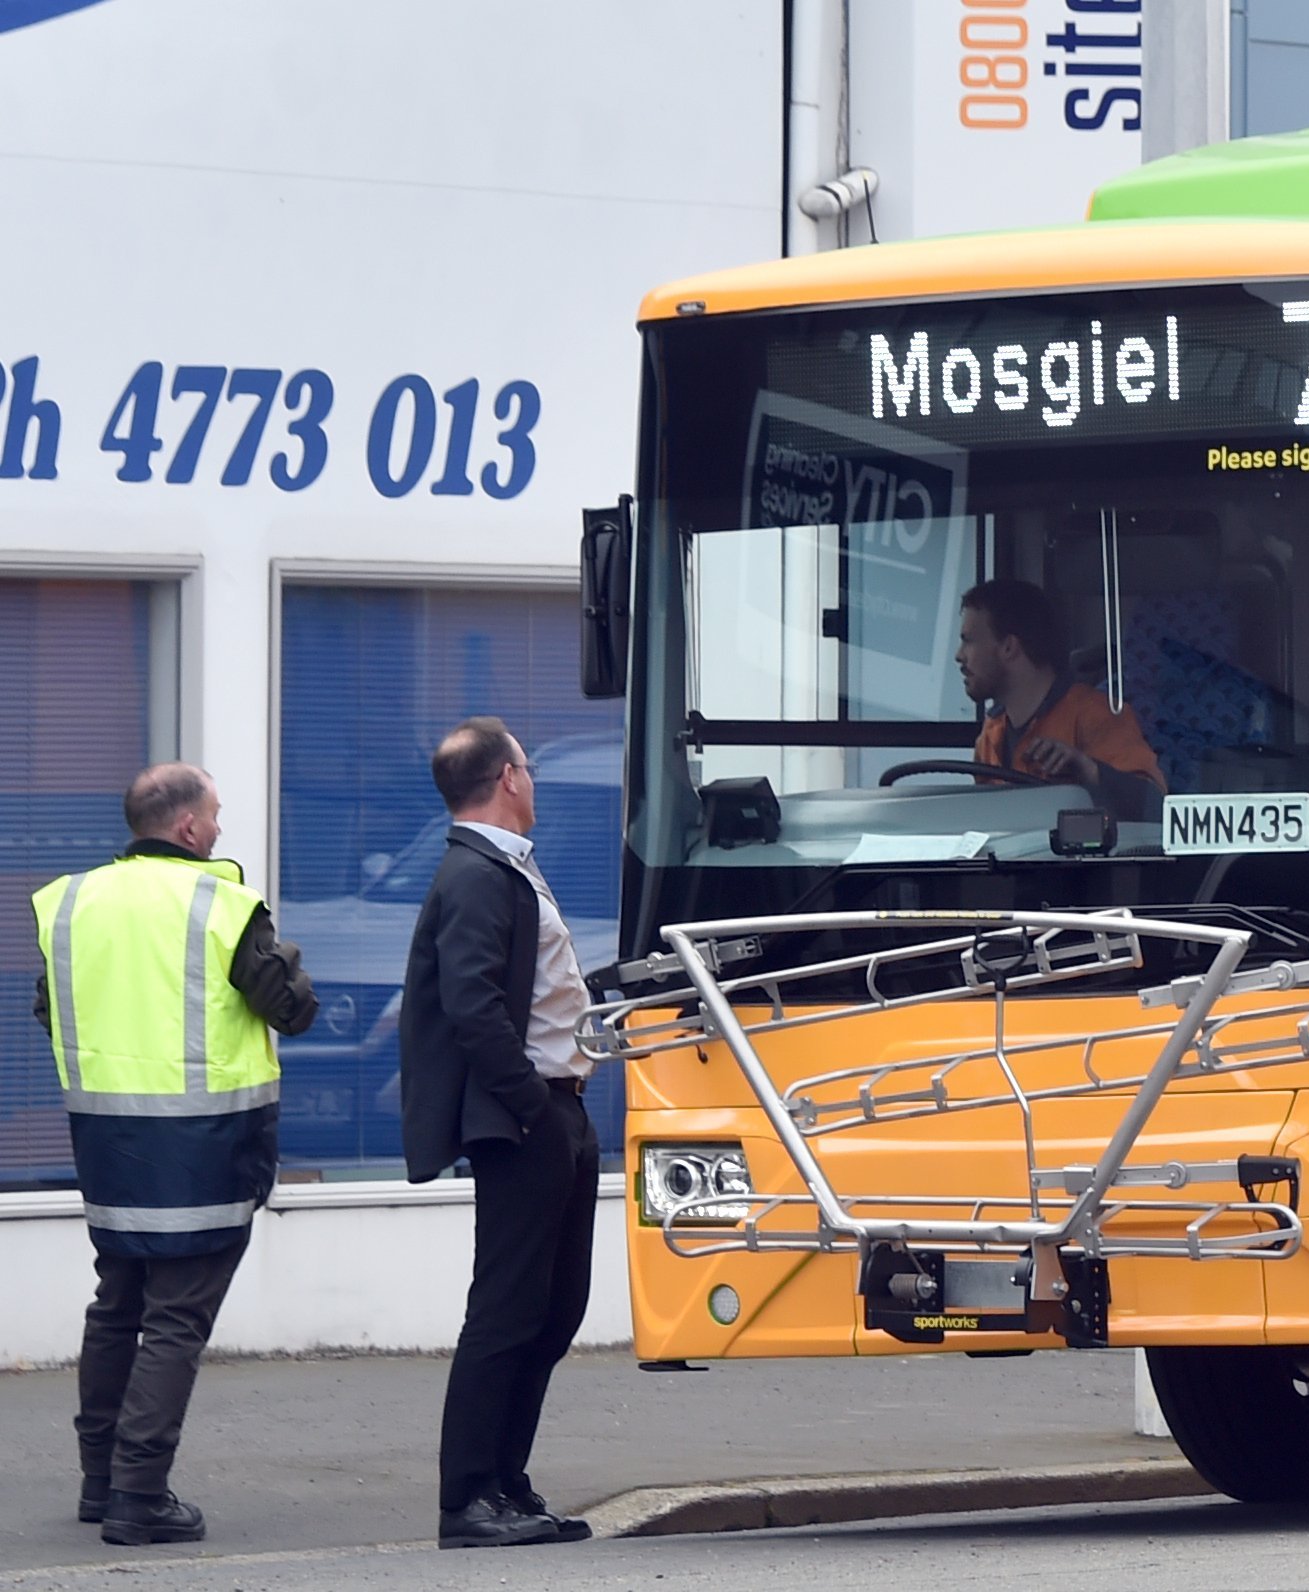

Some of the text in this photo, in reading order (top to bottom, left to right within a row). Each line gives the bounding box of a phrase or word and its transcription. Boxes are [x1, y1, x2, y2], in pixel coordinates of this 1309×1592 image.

[960, 0, 1028, 129] 080
[1044, 0, 1142, 131] sit
[870, 315, 1180, 427] Mosgiel
[0, 356, 541, 500] h 4773 013
[1207, 446, 1276, 471] Please
[1170, 804, 1302, 845] NMN435
[913, 1315, 979, 1330] sportworks
